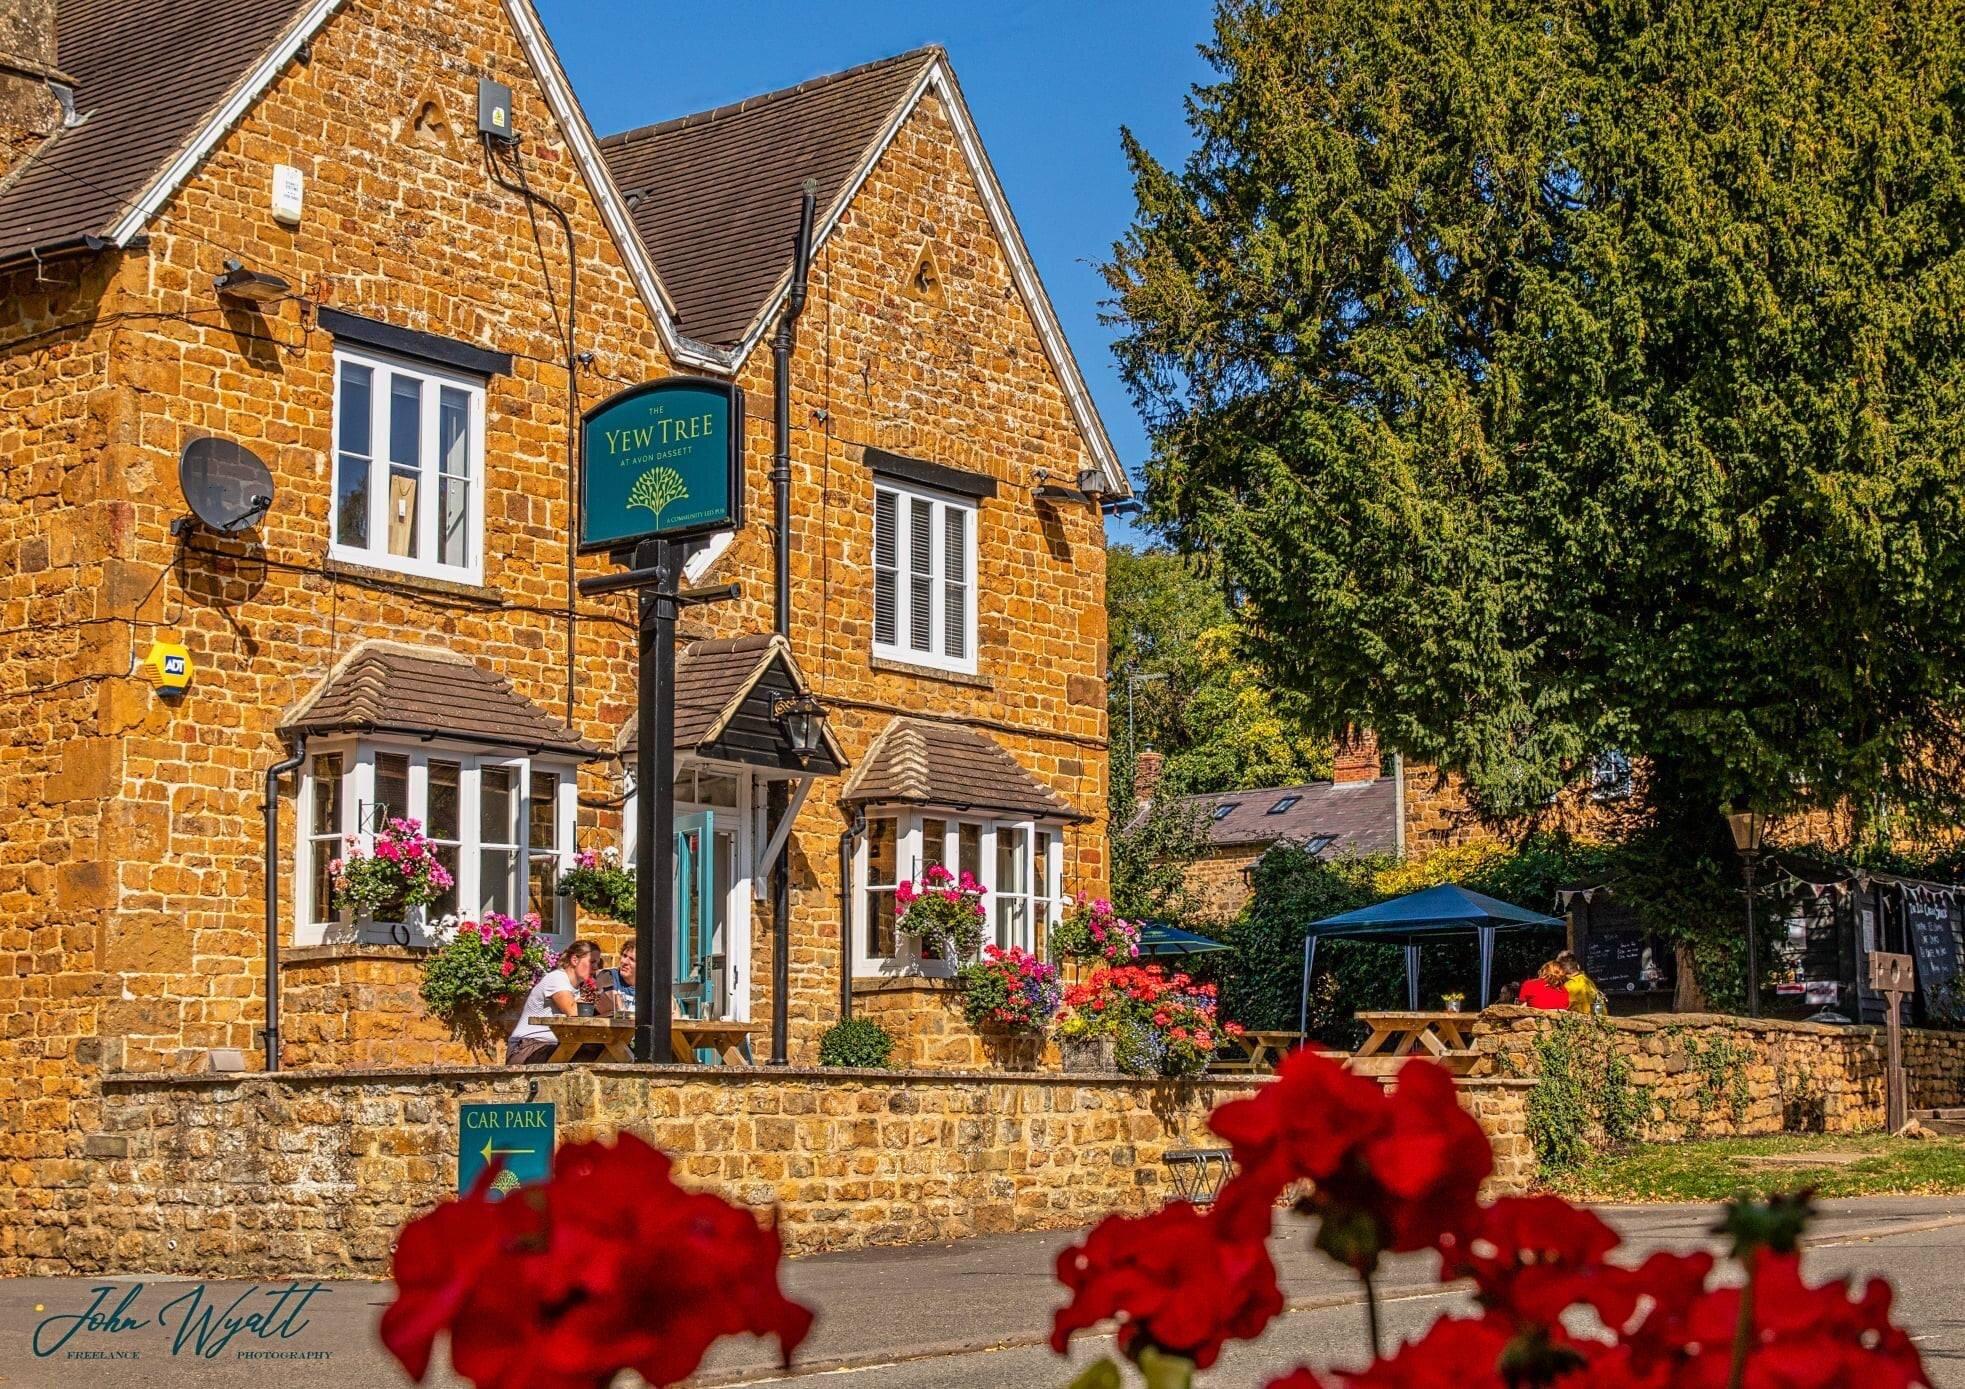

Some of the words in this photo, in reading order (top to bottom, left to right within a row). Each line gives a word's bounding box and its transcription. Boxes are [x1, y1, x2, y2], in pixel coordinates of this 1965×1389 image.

[649, 405, 664, 415] THE
[605, 426, 654, 454] YEW
[658, 414, 713, 444] TREE
[620, 458, 631, 466] AT
[632, 455, 654, 465] AVON
[657, 446, 692, 460] DASSETT
[165, 658, 184, 672] ADT
[467, 1111, 500, 1128] CAR
[505, 1110, 547, 1128] PARK
